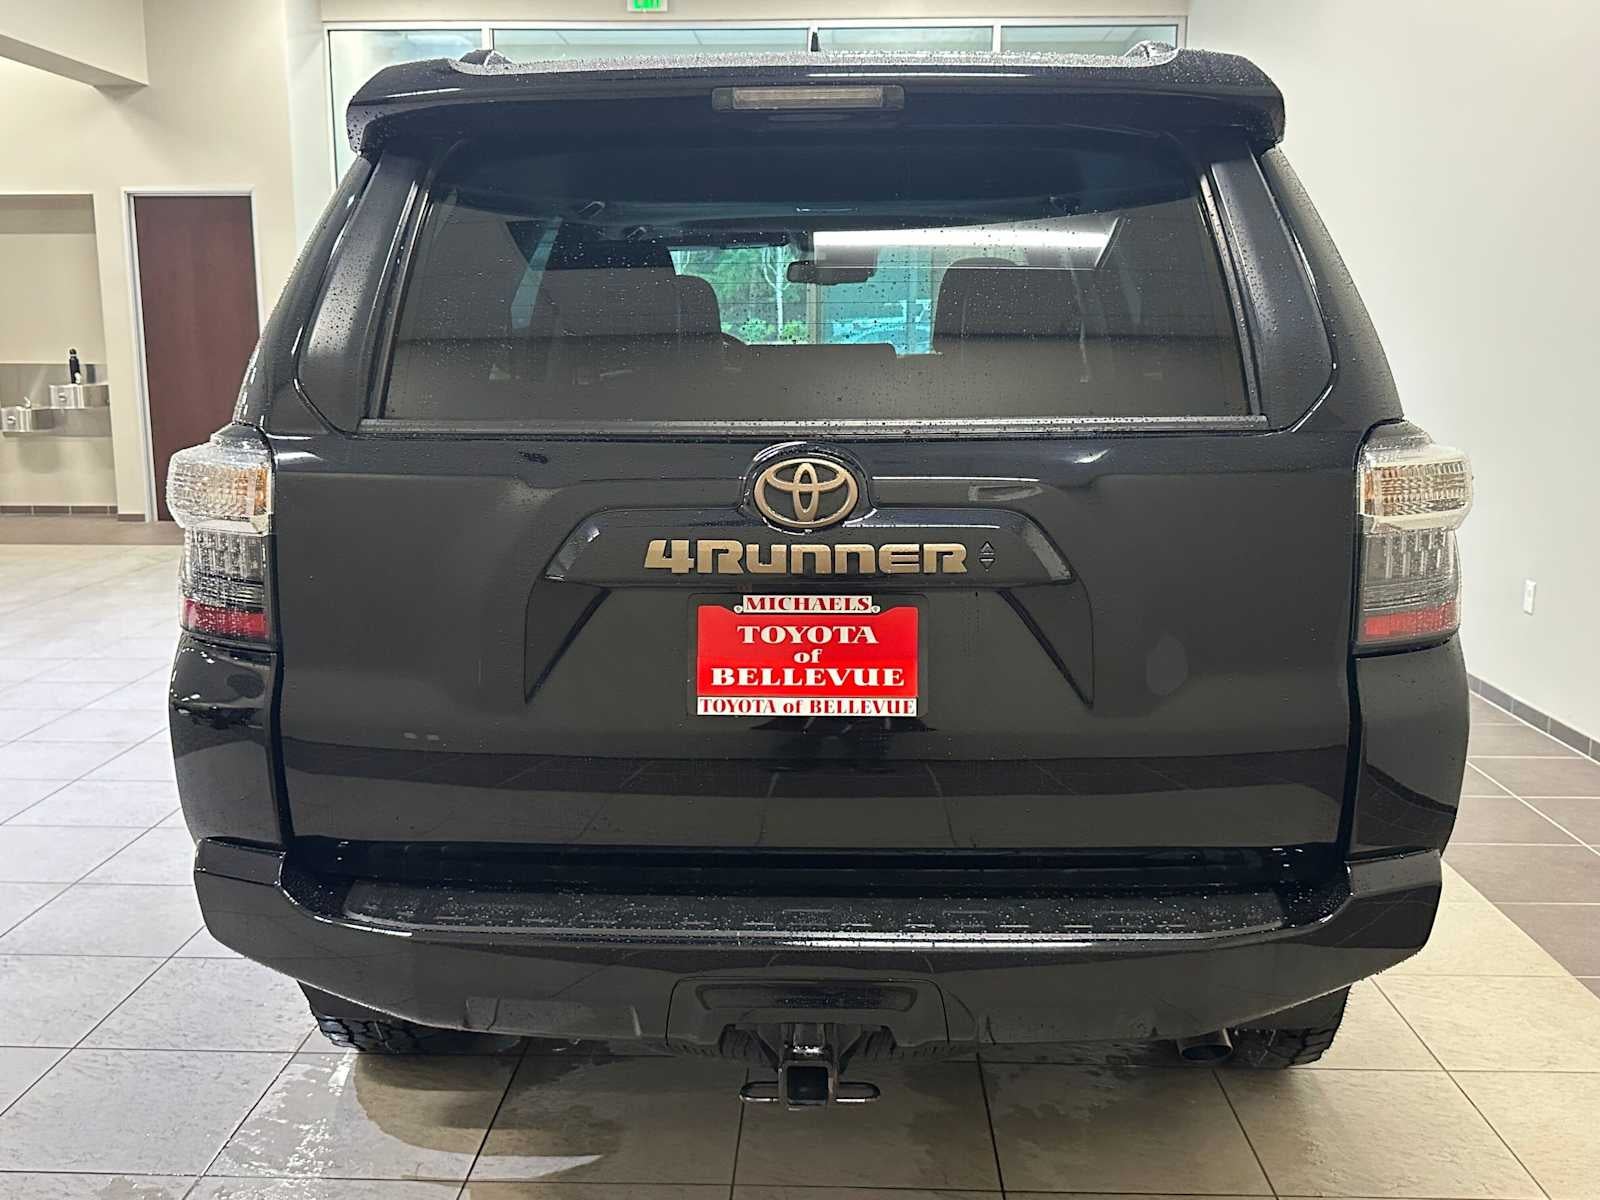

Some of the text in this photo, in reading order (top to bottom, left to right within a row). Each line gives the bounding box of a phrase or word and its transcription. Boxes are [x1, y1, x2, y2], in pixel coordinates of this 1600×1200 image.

[746, 597, 870, 611] MICHAELS
[737, 626, 879, 644] TOYOTA
[794, 649, 821, 663] of
[711, 669, 904, 686] BELLEVUE
[701, 698, 914, 714] TOYOTA of BELLEVUE
